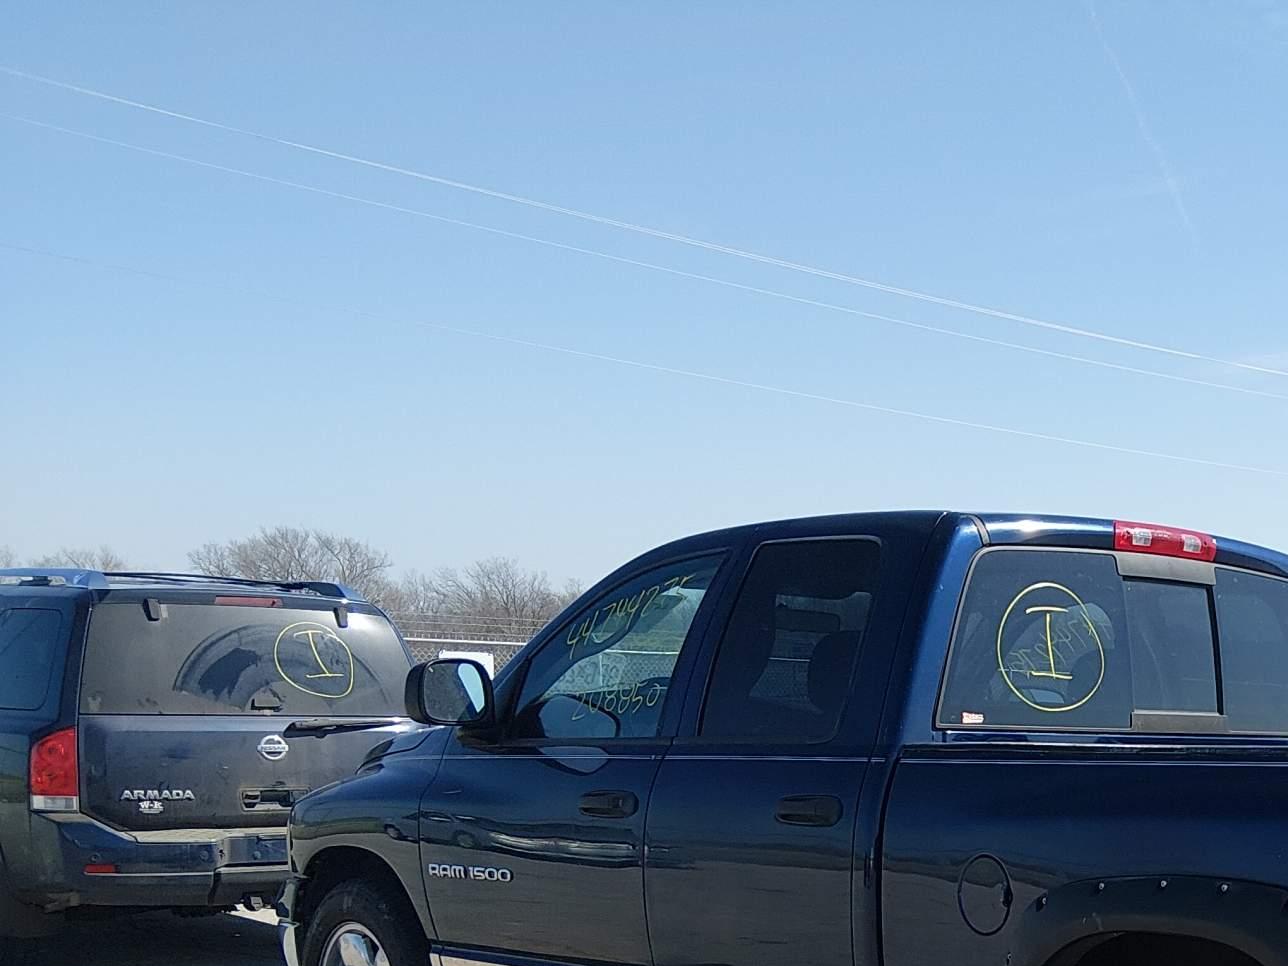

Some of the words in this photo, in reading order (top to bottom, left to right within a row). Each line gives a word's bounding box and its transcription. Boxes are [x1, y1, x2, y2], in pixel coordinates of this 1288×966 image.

[119, 789, 195, 801] ARMADA
[428, 863, 466, 879] RAM
[468, 866, 512, 882] 1500
